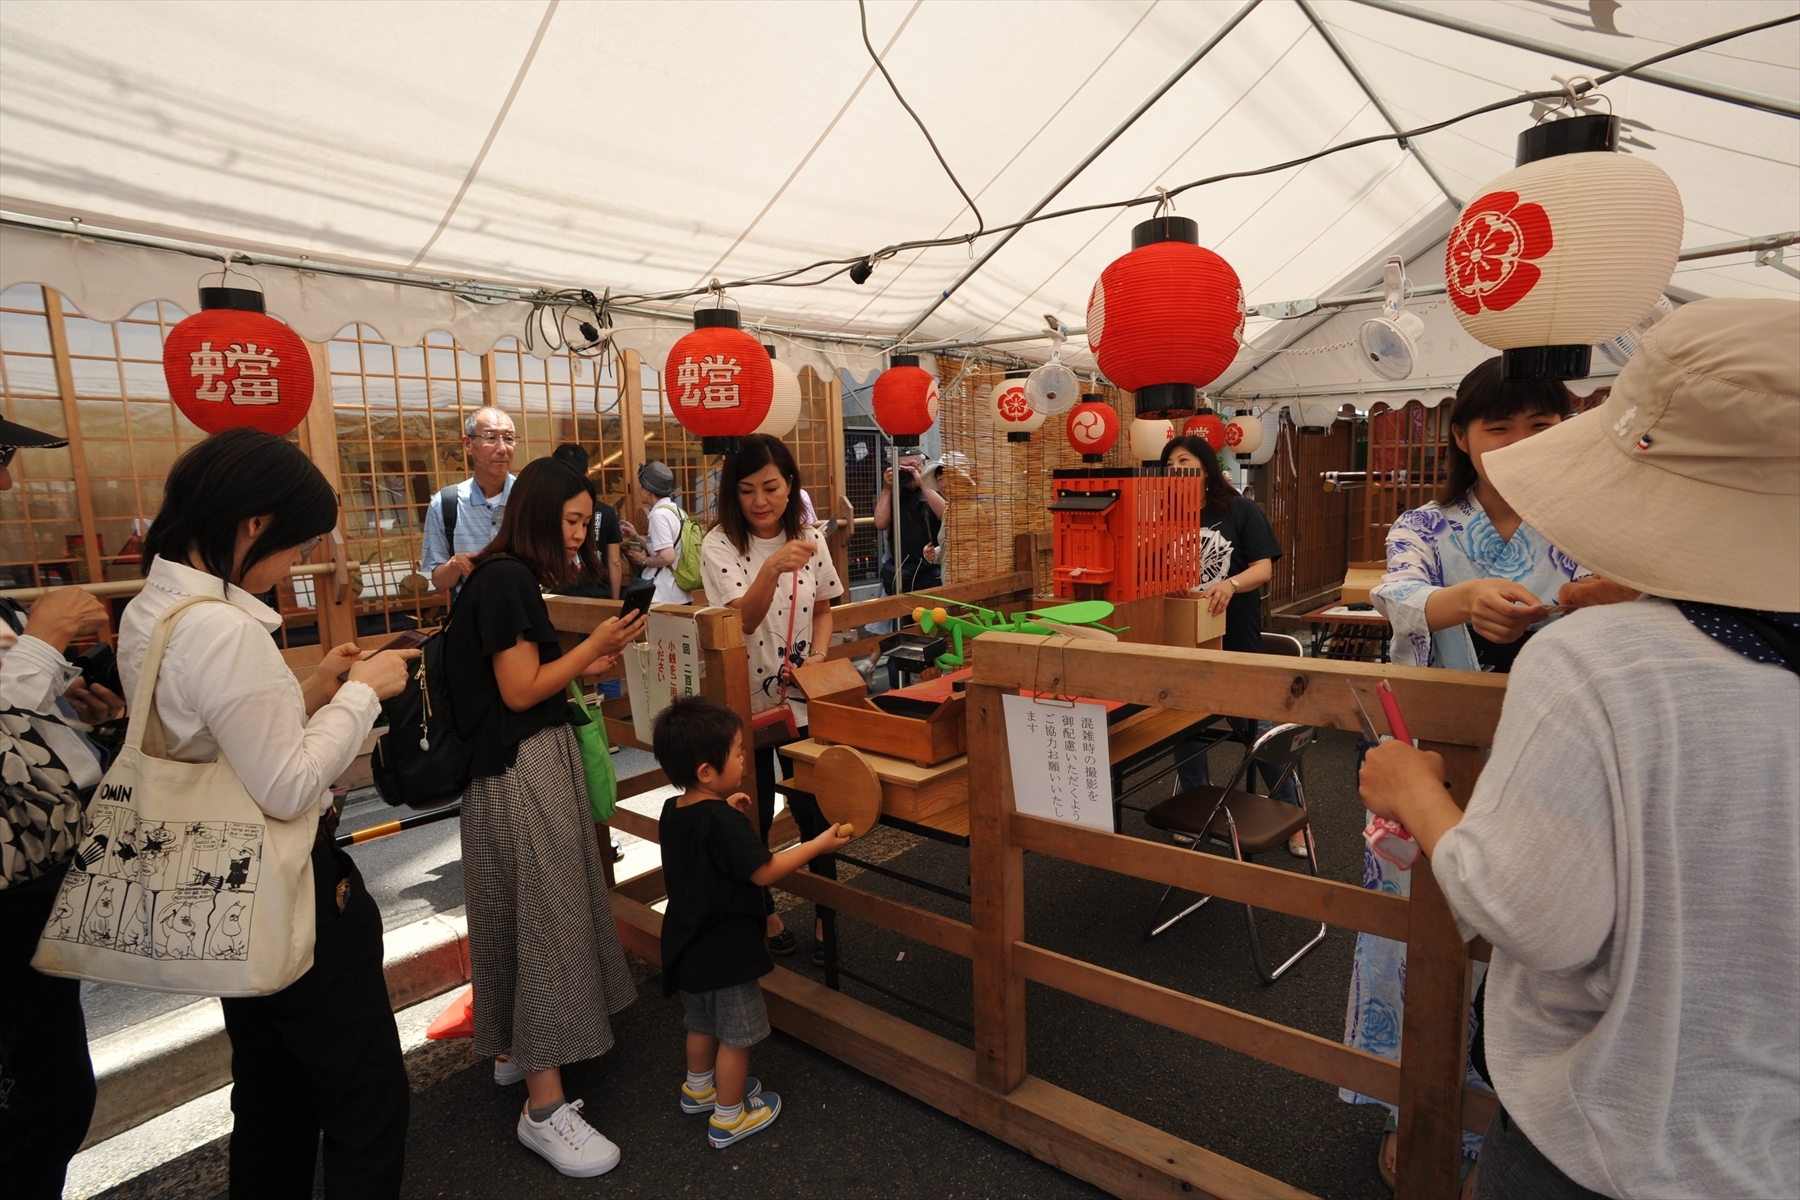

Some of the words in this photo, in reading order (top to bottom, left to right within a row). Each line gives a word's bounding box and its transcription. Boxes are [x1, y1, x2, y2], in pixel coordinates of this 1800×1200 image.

[657, 639, 665, 683] ください
[667, 641, 678, 708] 小銭をご用
[1026, 710, 1038, 733] ます
[1045, 712, 1063, 818] ご協力お願いいたし
[1061, 714, 1080, 821] 御配慮いただくよう
[1081, 716, 1098, 802] 混雑時の撮影を
[99, 783, 133, 803] OMIN
